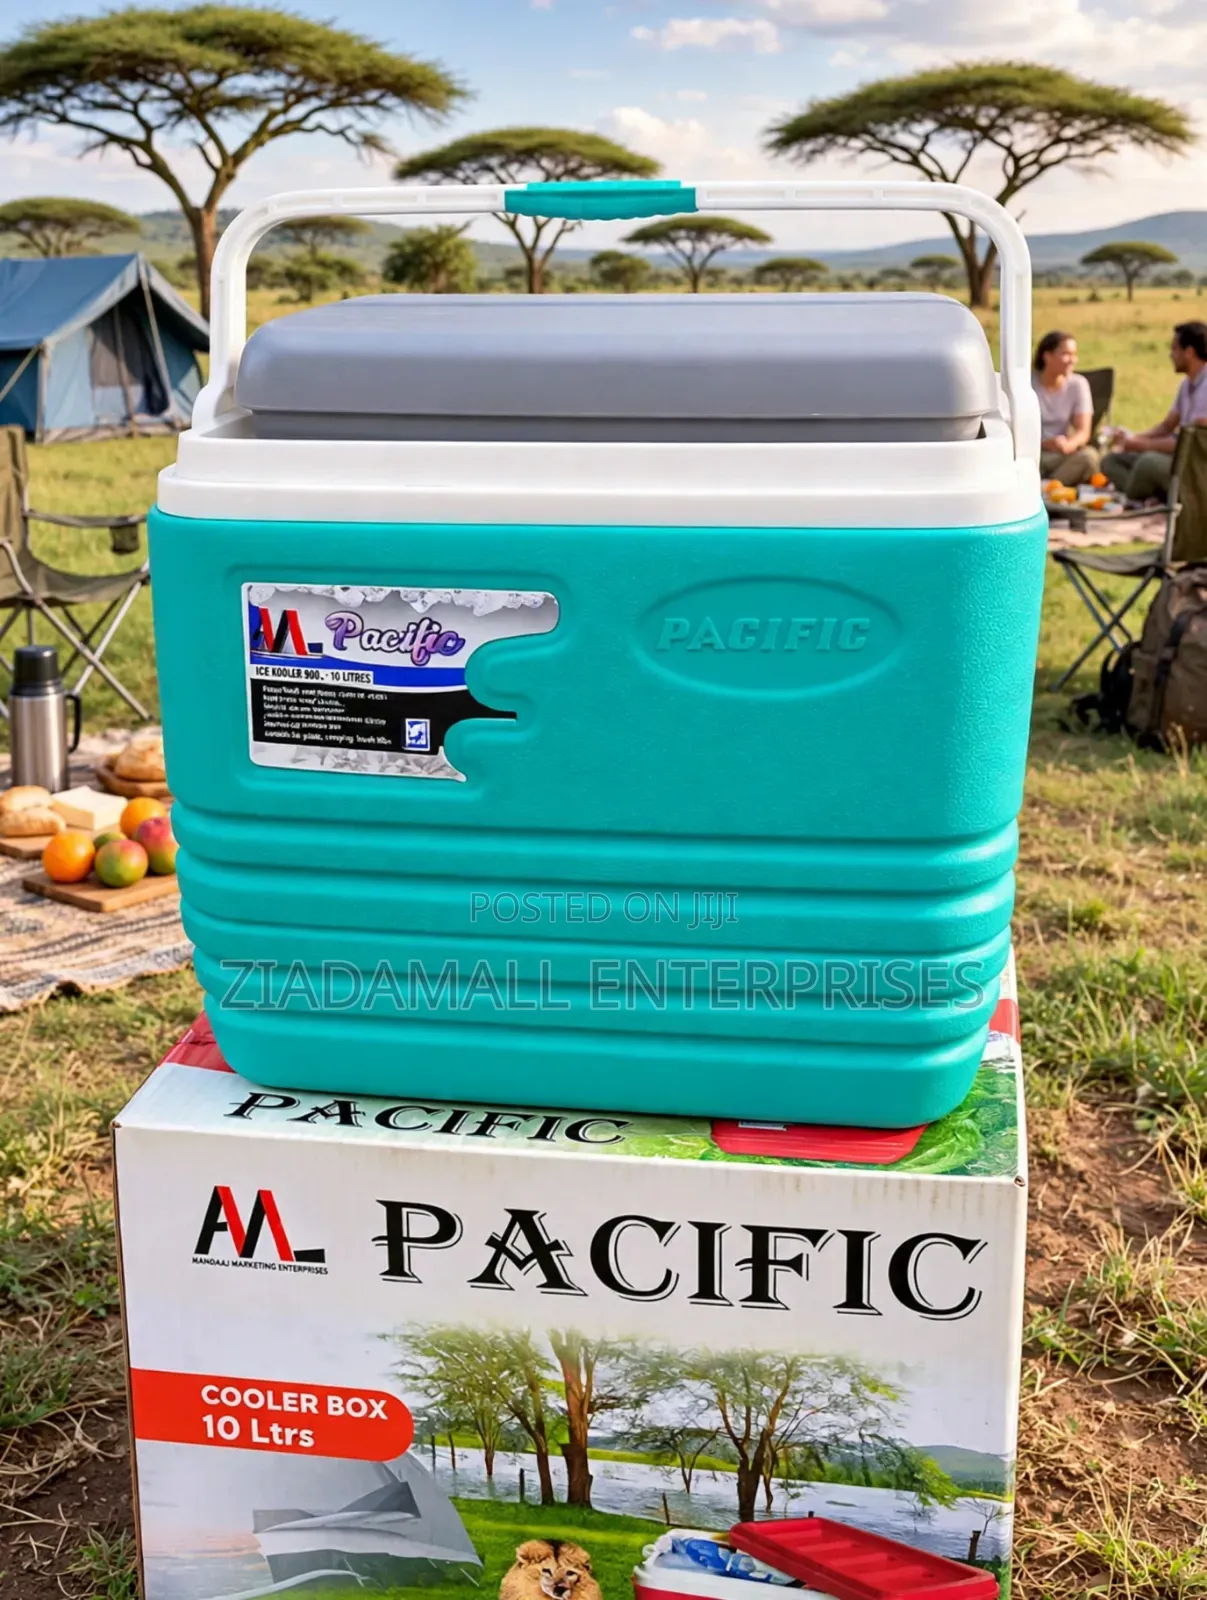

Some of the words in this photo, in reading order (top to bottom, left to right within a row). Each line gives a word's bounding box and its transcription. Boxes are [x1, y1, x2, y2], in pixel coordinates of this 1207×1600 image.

[324, 611, 466, 666] Pacific
[655, 615, 871, 653] PACIFIC
[255, 666, 270, 677] ICE
[272, 667, 303, 679] KOOLER
[330, 671, 341, 682] 10
[342, 671, 372, 684] LITRES
[223, 1091, 633, 1145] PACIFIC
[191, 1257, 231, 1268] MANDAAJ
[231, 1260, 277, 1271] MARKETING
[278, 1264, 329, 1275] ENTERPRISES
[372, 1199, 988, 1320] PACIFIC
[201, 1384, 319, 1415] COOLER
[327, 1395, 388, 1421] BOX
[202, 1413, 240, 1441] 10
[251, 1418, 315, 1448] Ltrs
